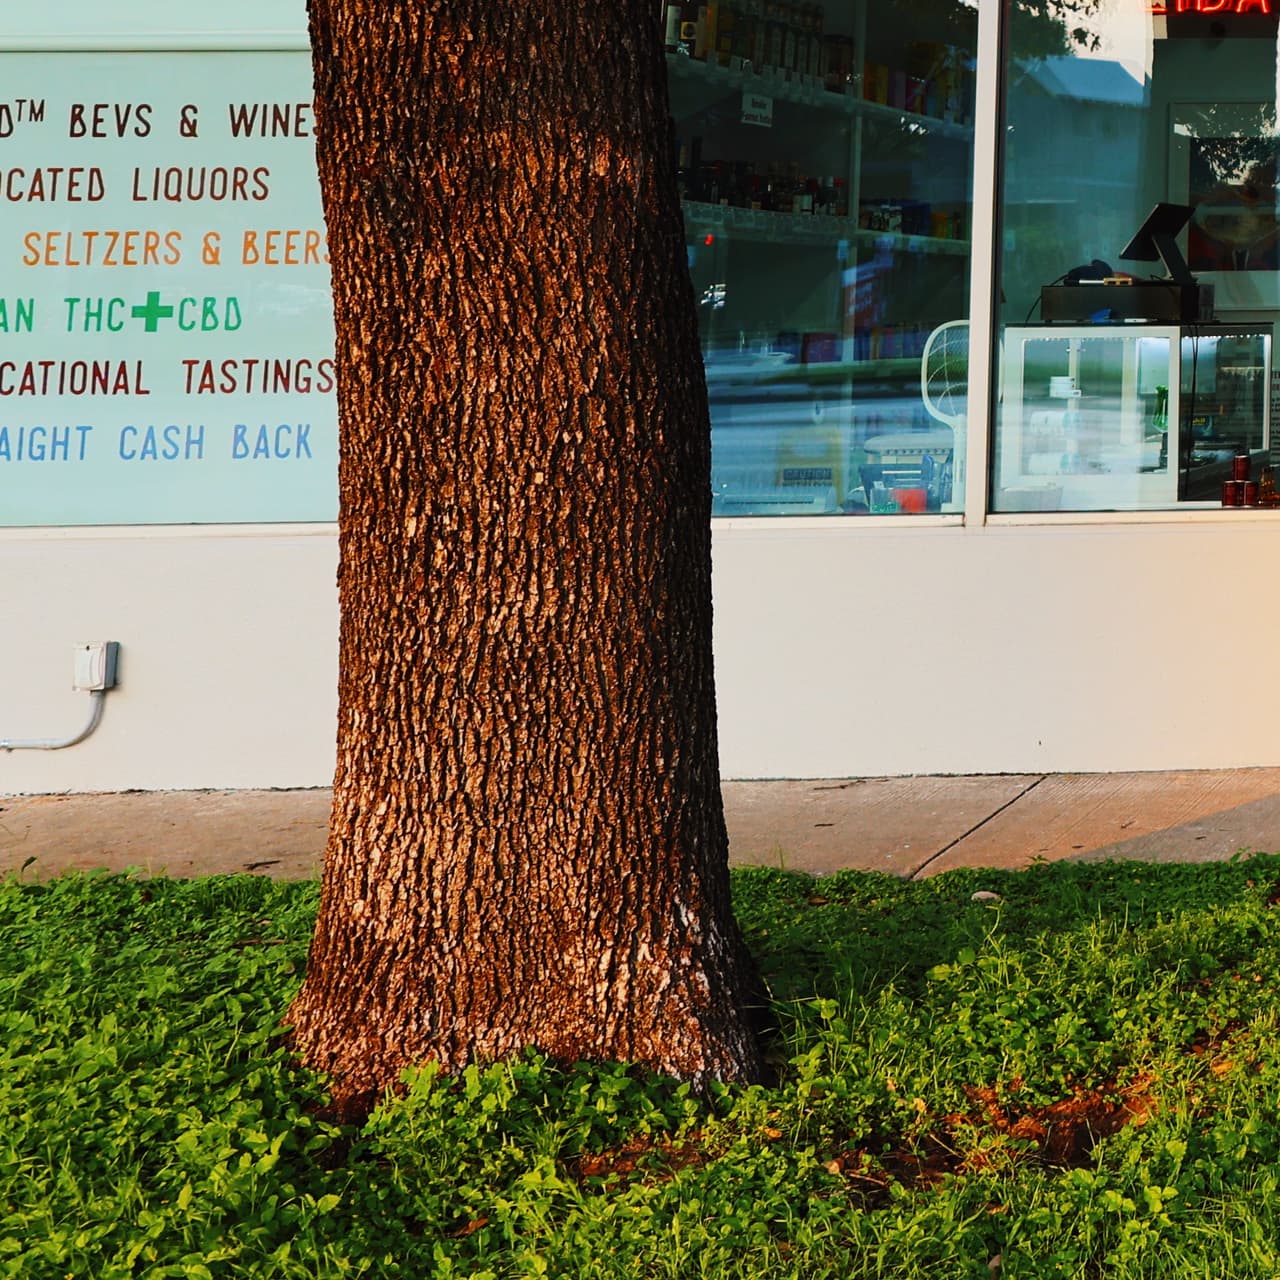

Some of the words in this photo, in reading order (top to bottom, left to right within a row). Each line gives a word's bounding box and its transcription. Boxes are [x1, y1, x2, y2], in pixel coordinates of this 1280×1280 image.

[69, 103, 152, 138] BEVS
[179, 104, 199, 138] &
[229, 103, 318, 138] WINE
[0, 167, 105, 202] CATED
[133, 167, 270, 202] LIQUORS
[23, 231, 182, 266] SELTZERS
[202, 231, 221, 265] &
[182, 359, 335, 395] TASTINGS
[119, 425, 204, 460] CASH
[232, 424, 312, 459] BACK
